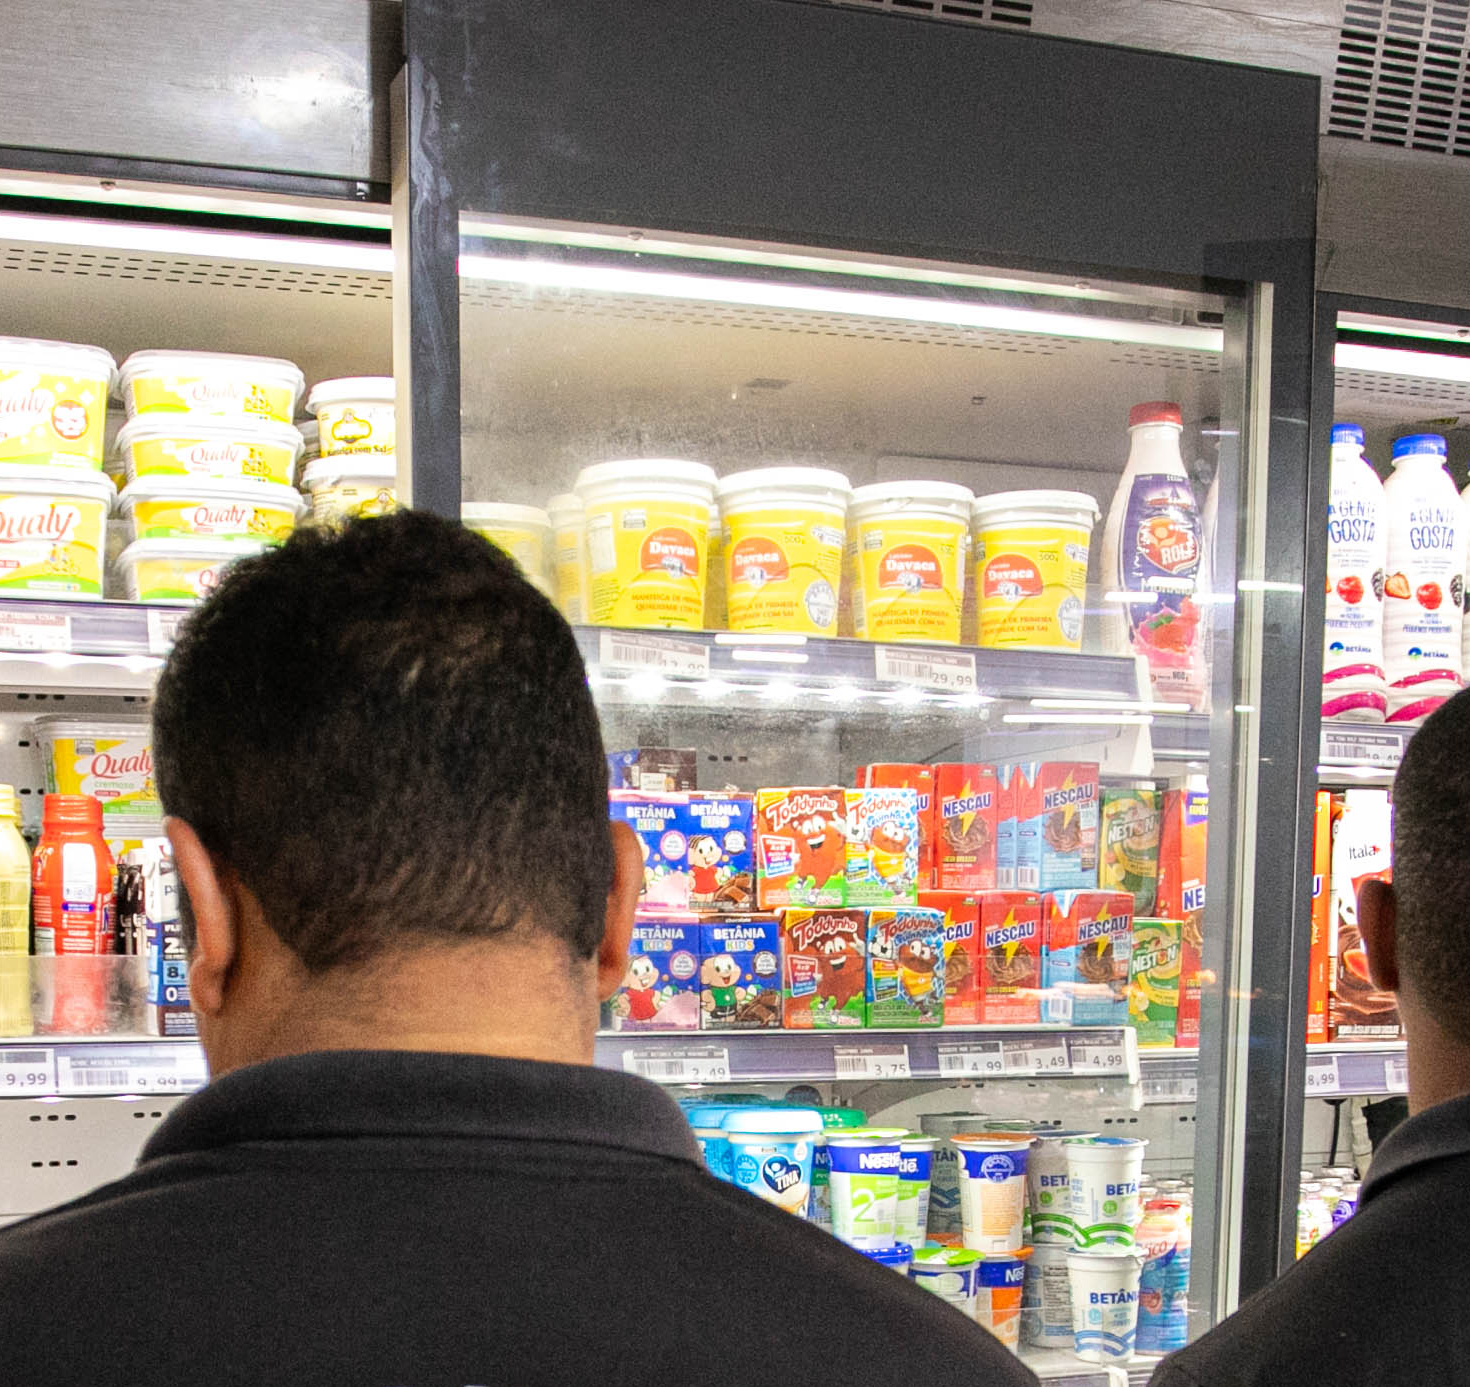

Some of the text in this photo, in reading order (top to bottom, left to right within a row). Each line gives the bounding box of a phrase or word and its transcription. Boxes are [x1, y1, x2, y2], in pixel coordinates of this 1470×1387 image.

[193, 504, 247, 525] Qualy
[1410, 525, 1455, 550] GOSTA
[649, 540, 696, 558] Davaca
[885, 559, 936, 573] Davaca
[987, 568, 1035, 582] Davaca
[931, 672, 973, 687] 29,99
[1044, 783, 1094, 809] NESCAU
[626, 804, 677, 820] BETÂNIA
[690, 801, 742, 817] BETÂNIA
[943, 792, 992, 818] NESCAU
[766, 796, 837, 832] Toddynho
[713, 925, 766, 940] BETÂNIA
[793, 915, 858, 951] Toddynho
[880, 917, 939, 944] Toddynho
[985, 921, 1035, 948] NESCAU
[1078, 915, 1129, 941] NESCAU
[642, 940, 673, 952] KIDS
[725, 940, 756, 952] KIDS
[1132, 944, 1178, 973] NESTON
[1035, 1055, 1066, 1069] 3,49
[1092, 1053, 1123, 1067] 4,99
[874, 1063, 907, 1077] 3,75
[5, 1073, 48, 1087] 9,99
